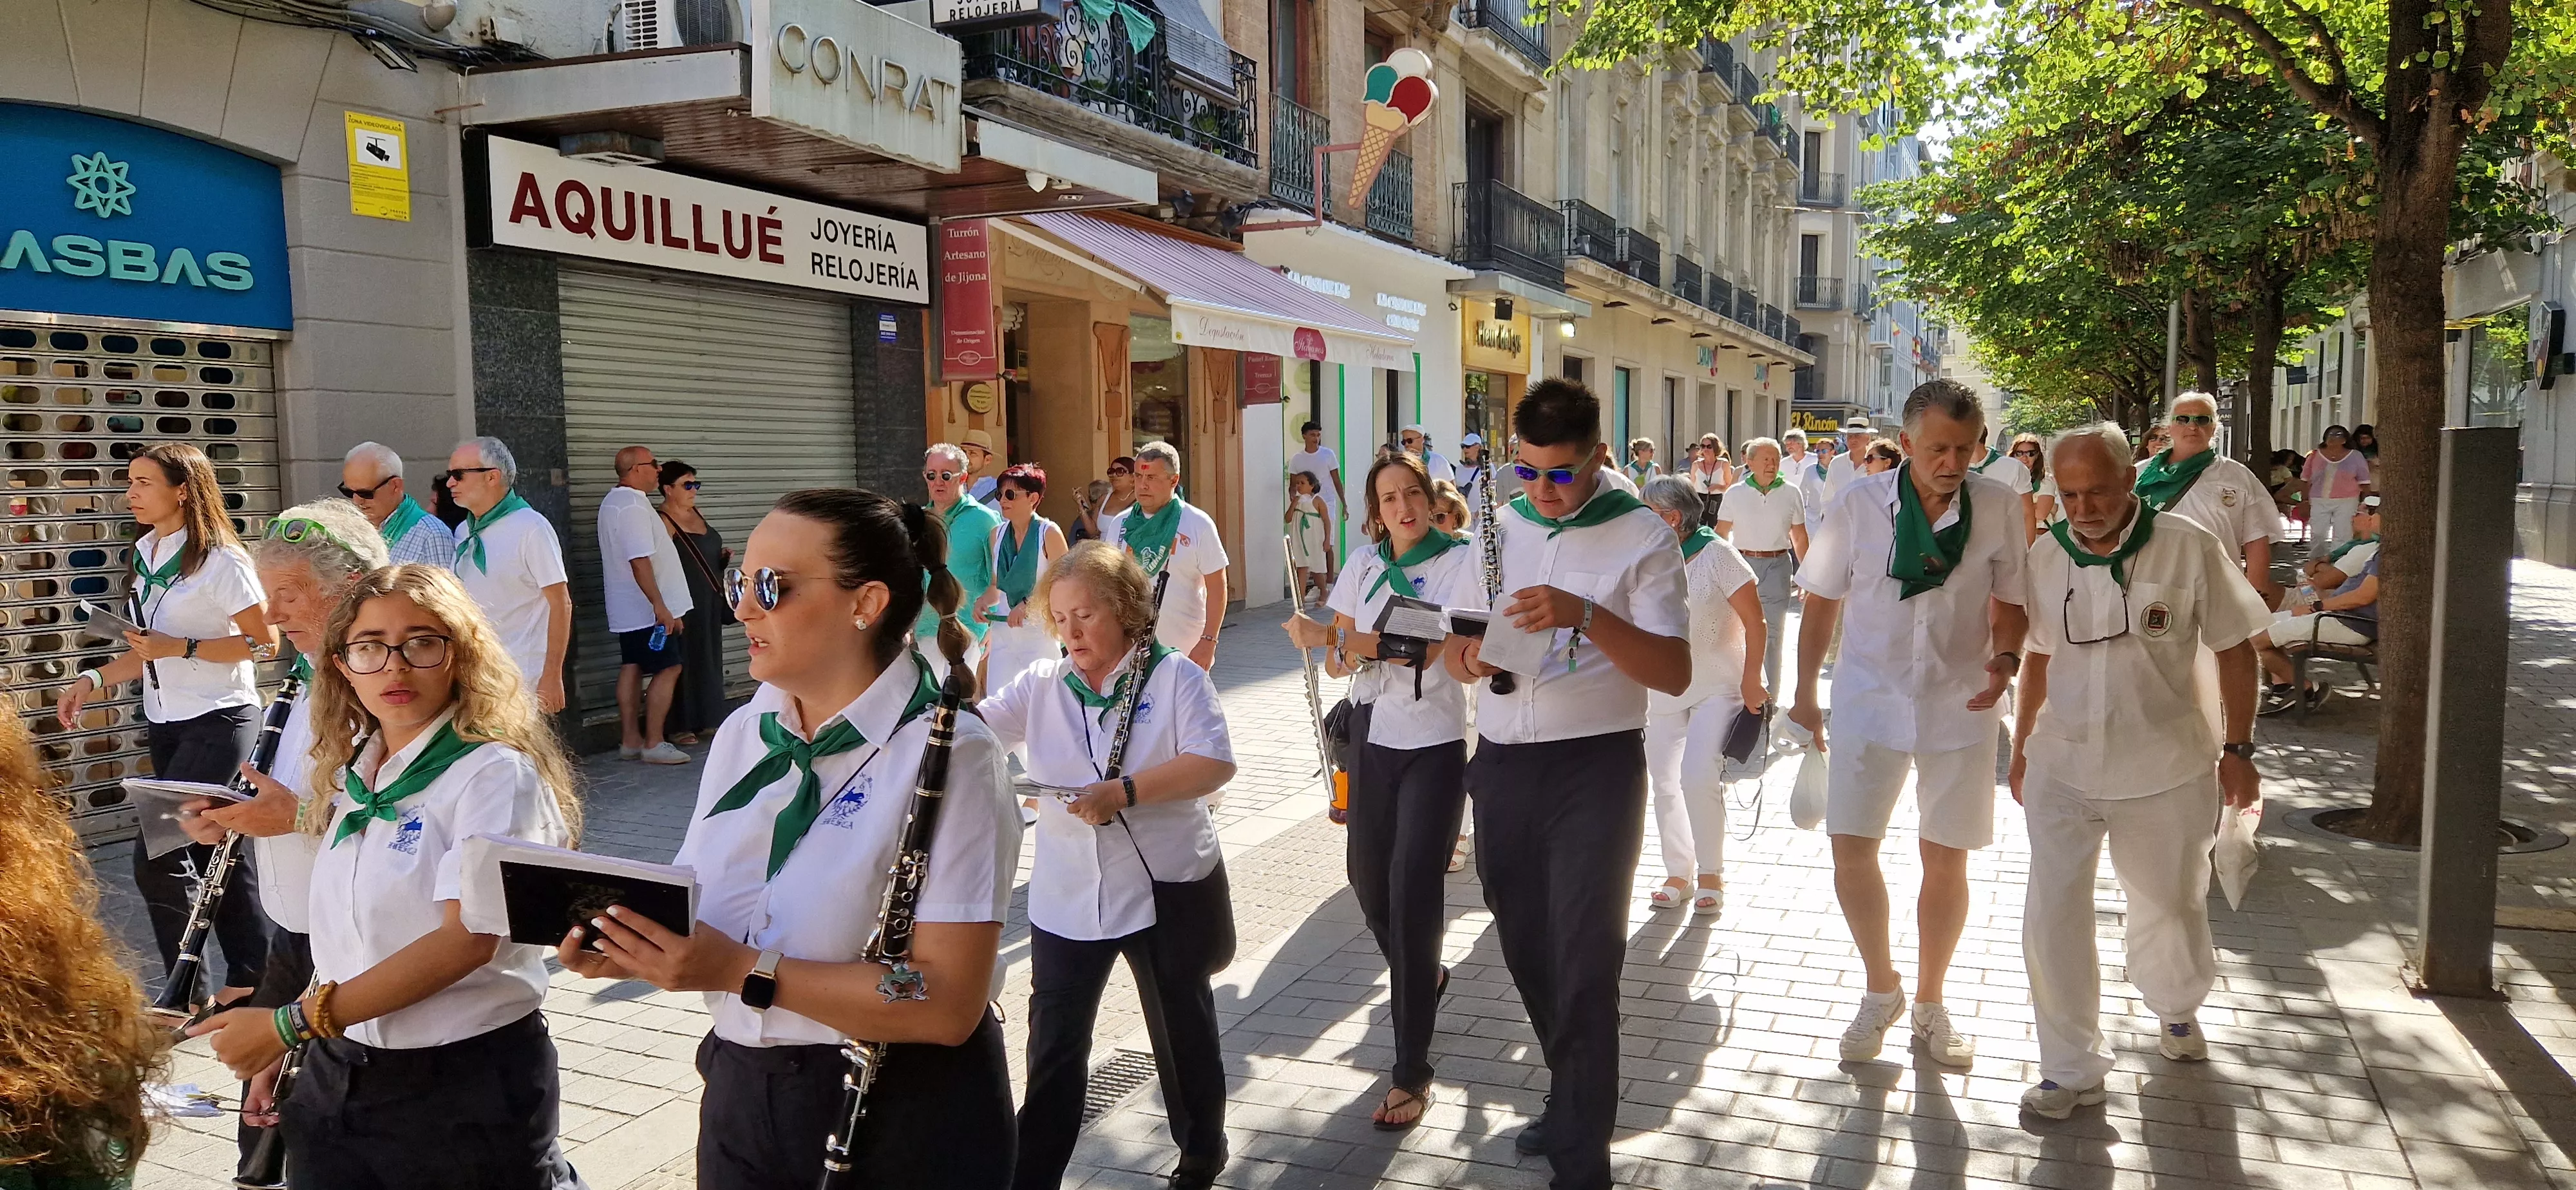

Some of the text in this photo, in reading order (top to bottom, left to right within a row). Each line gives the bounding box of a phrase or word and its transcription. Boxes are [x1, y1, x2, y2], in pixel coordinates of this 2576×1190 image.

[950, 1, 1021, 21] RELOJERIA
[777, 23, 958, 124] CONRAT
[364, 121, 402, 132] VIDEOVIGILADA
[509, 172, 785, 265] AQUILLUÉ
[811, 216, 897, 254] JOYERÍA
[947, 227, 980, 238] Turrón
[943, 250, 987, 261] Artesano
[811, 252, 920, 291] RELOJERÍA
[945, 271, 987, 285] de Jijona
[1198, 314, 1245, 343] Degustación
[1803, 412, 1839, 431] Rincón
